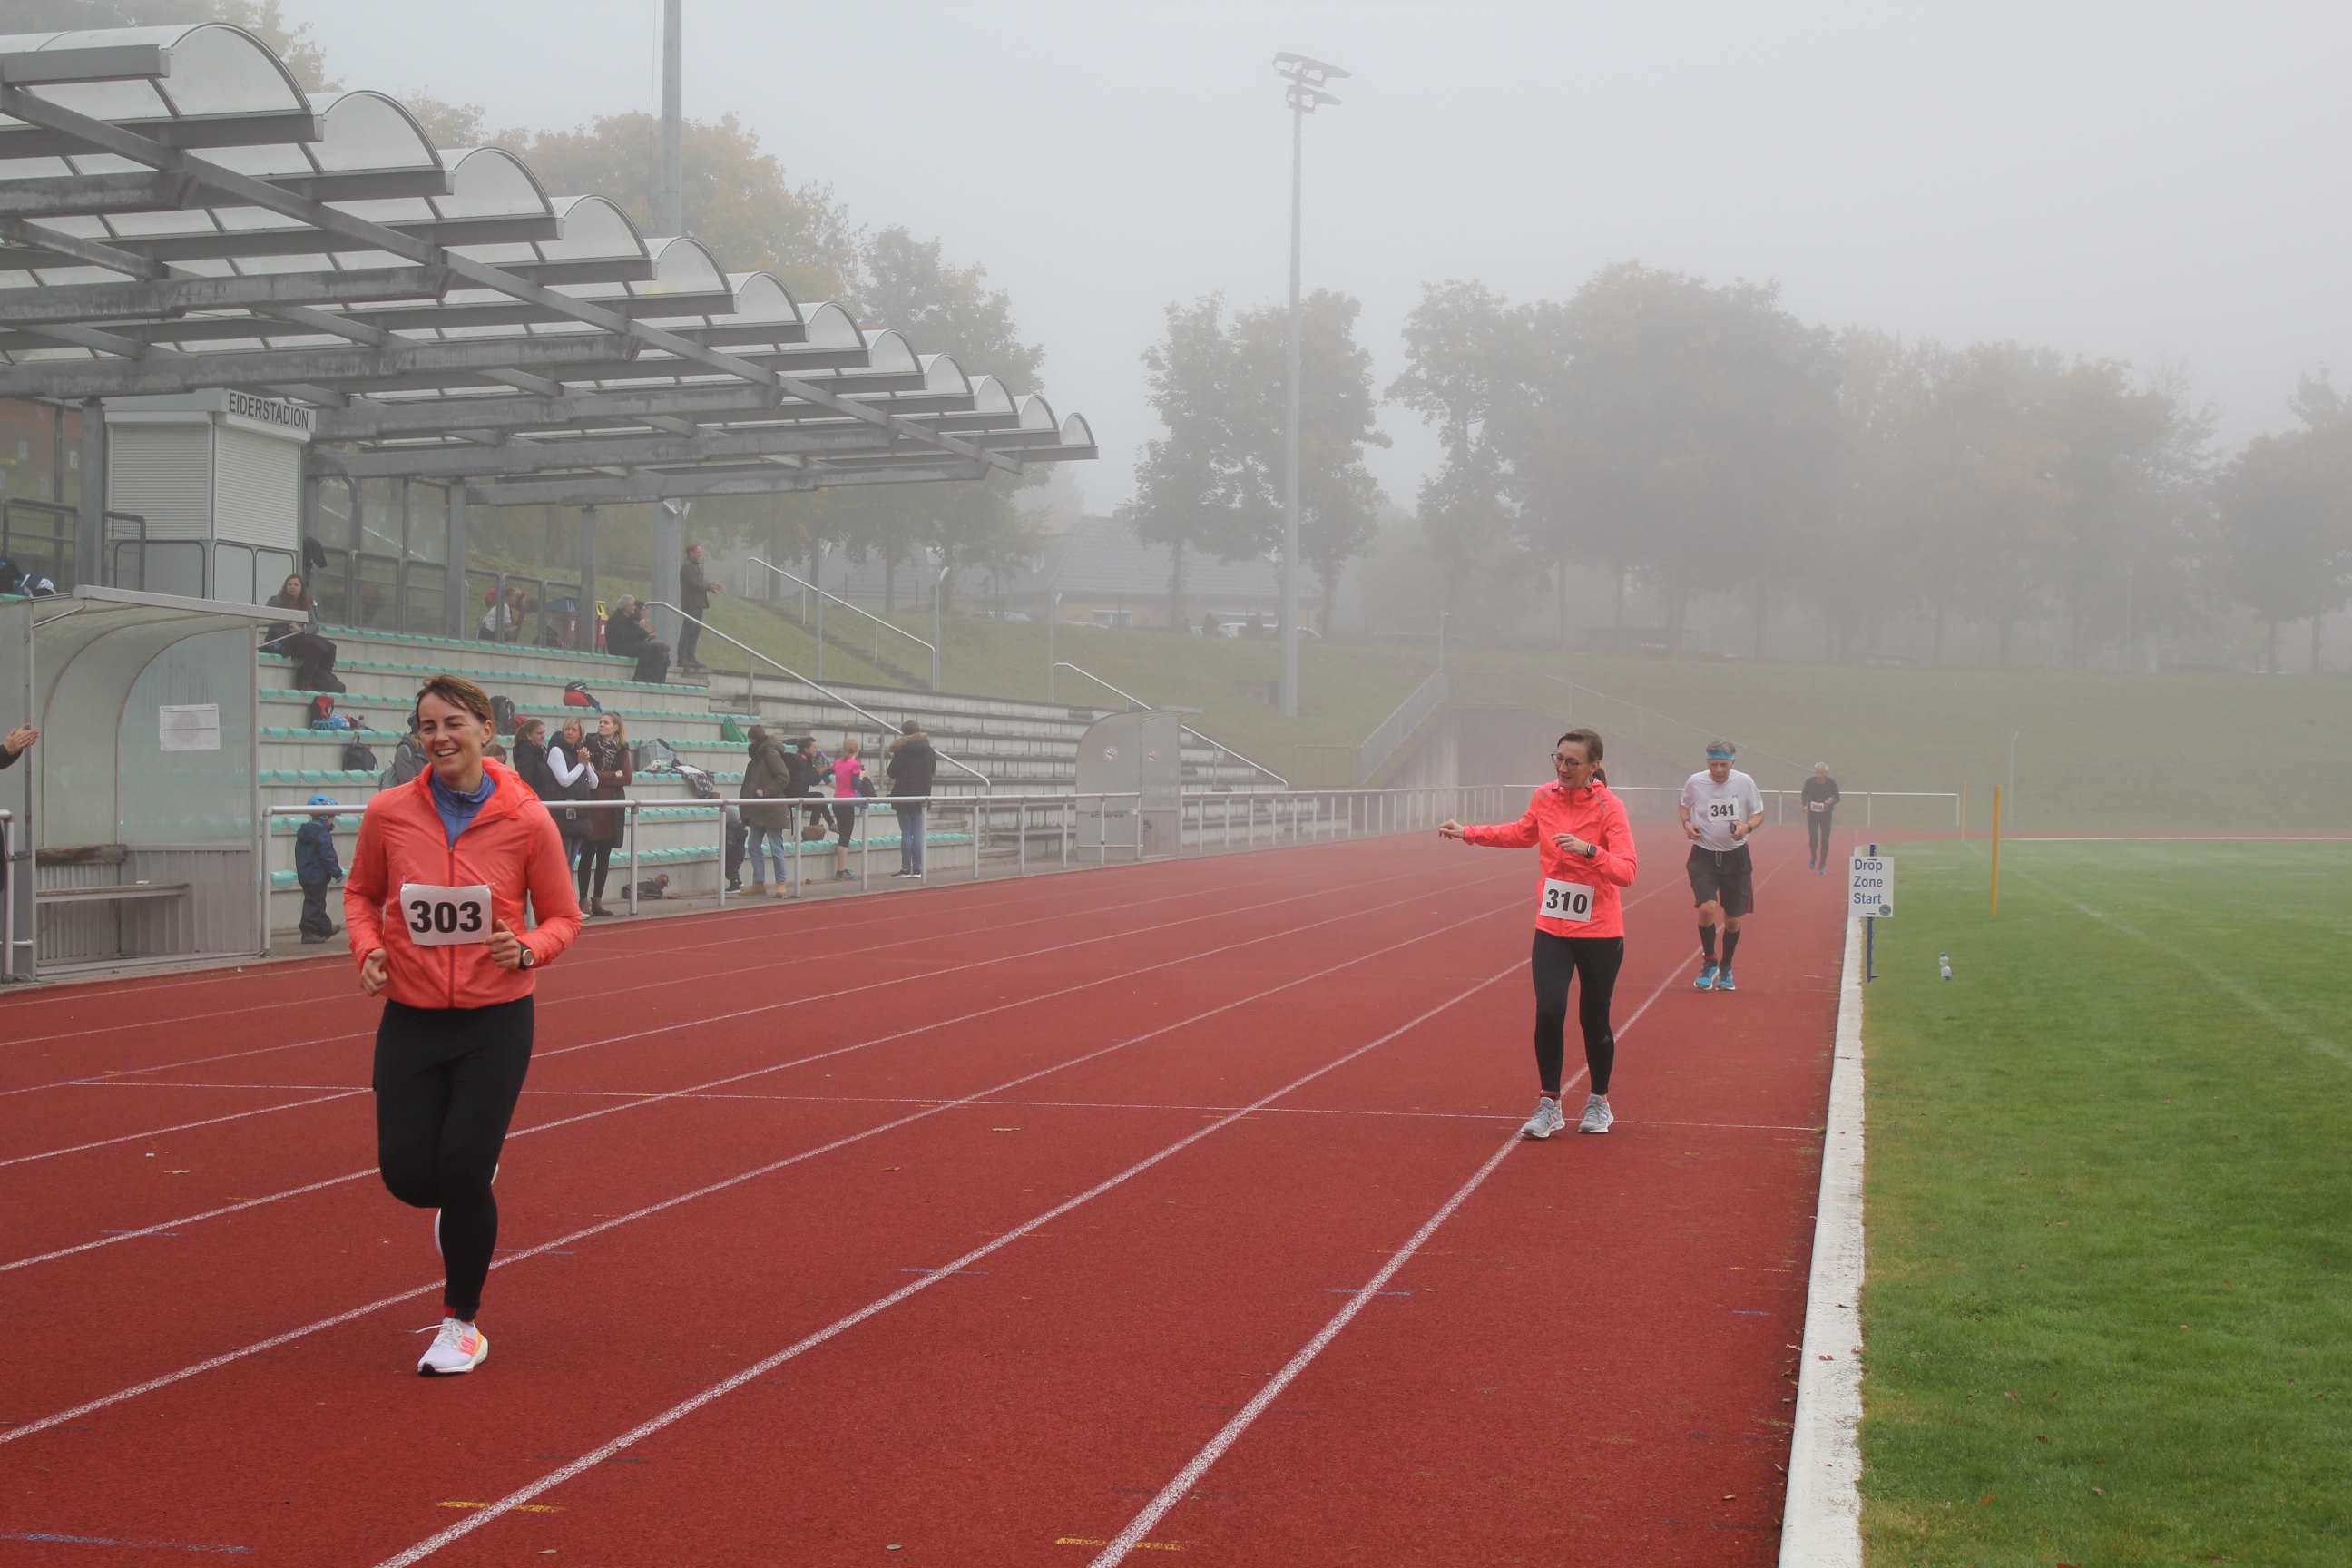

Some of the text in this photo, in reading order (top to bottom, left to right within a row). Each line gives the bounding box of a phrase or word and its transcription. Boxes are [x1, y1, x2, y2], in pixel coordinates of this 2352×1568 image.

[229, 393, 309, 429] EIDERSTADION
[1710, 803, 1734, 817] 341
[1854, 858, 1883, 873] Drop
[1853, 876, 1883, 887] Zone
[1546, 888, 1588, 915] 310
[1853, 892, 1882, 904] Start
[409, 900, 482, 934] 303
